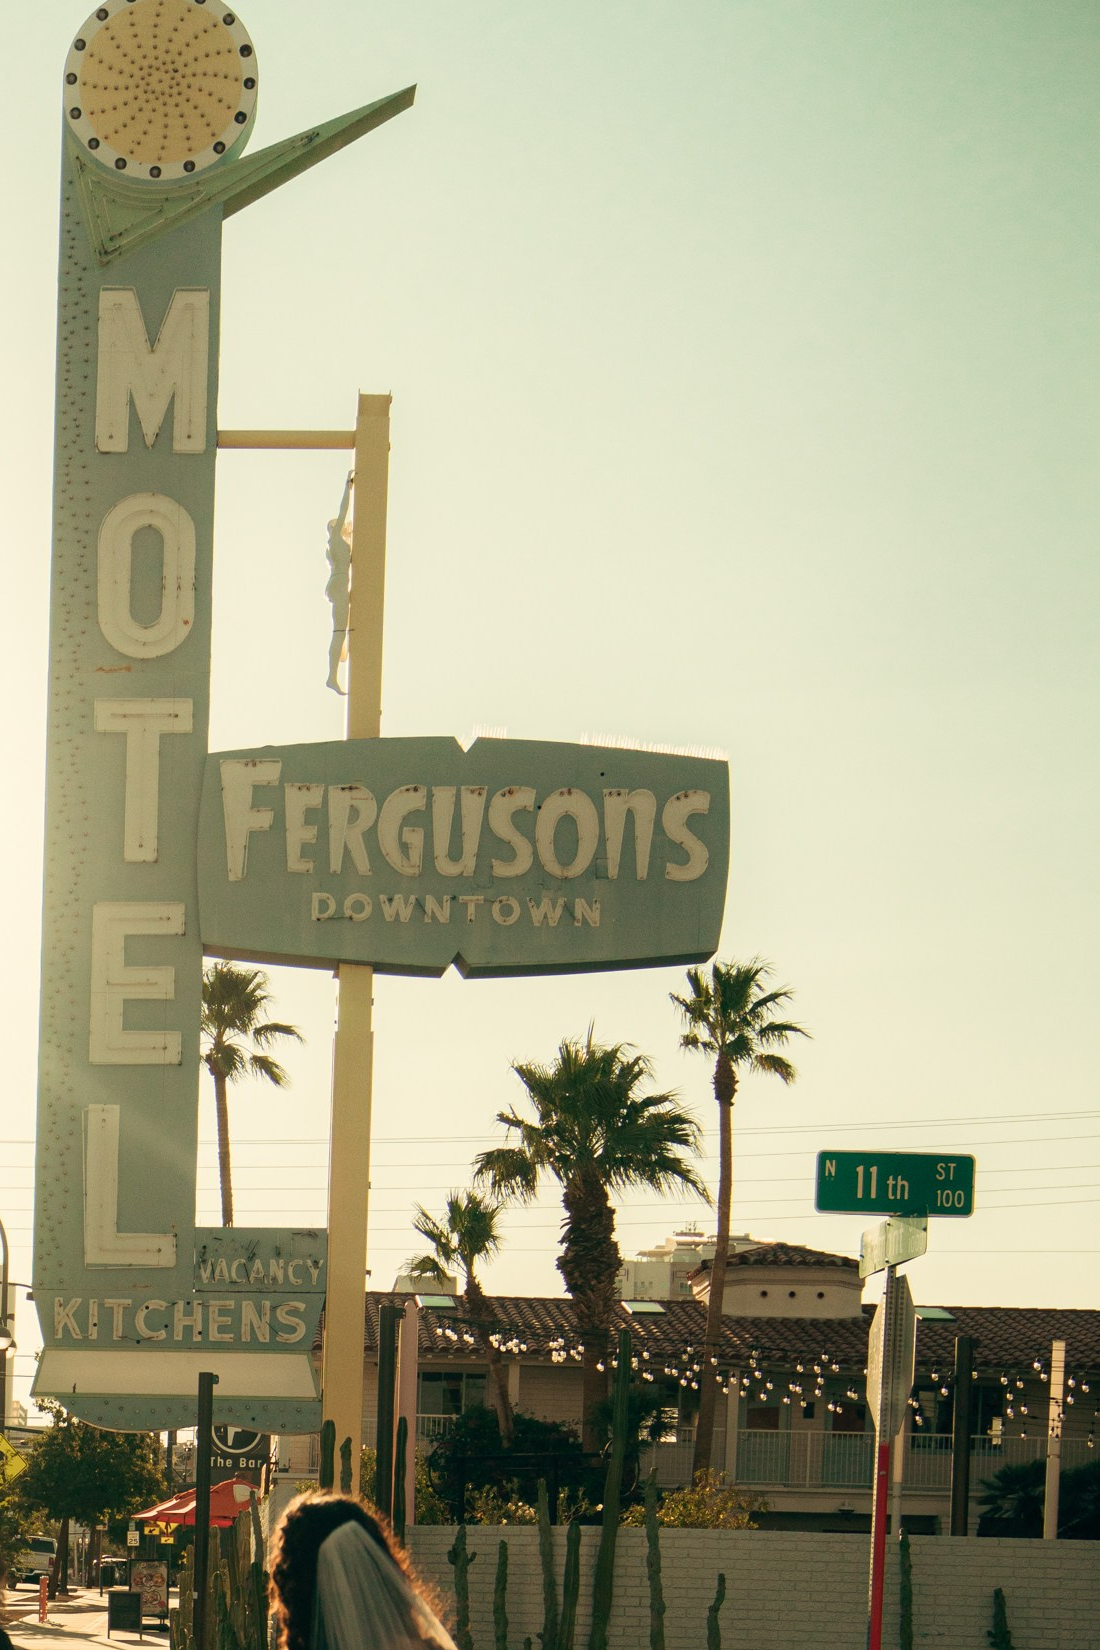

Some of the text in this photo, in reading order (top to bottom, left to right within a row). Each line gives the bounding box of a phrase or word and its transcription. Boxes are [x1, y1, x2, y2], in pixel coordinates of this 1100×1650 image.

[82, 286, 210, 1269] MOTEL
[311, 891, 601, 927] DOWNTOWN
[825, 1159, 836, 1177] N
[935, 1163, 957, 1180] ST
[936, 1190, 965, 1208] 100
[199, 1258, 324, 1286] VACANCY
[54, 1297, 306, 1343] KITCHENS
[210, 1456, 262, 1468] The Bar
